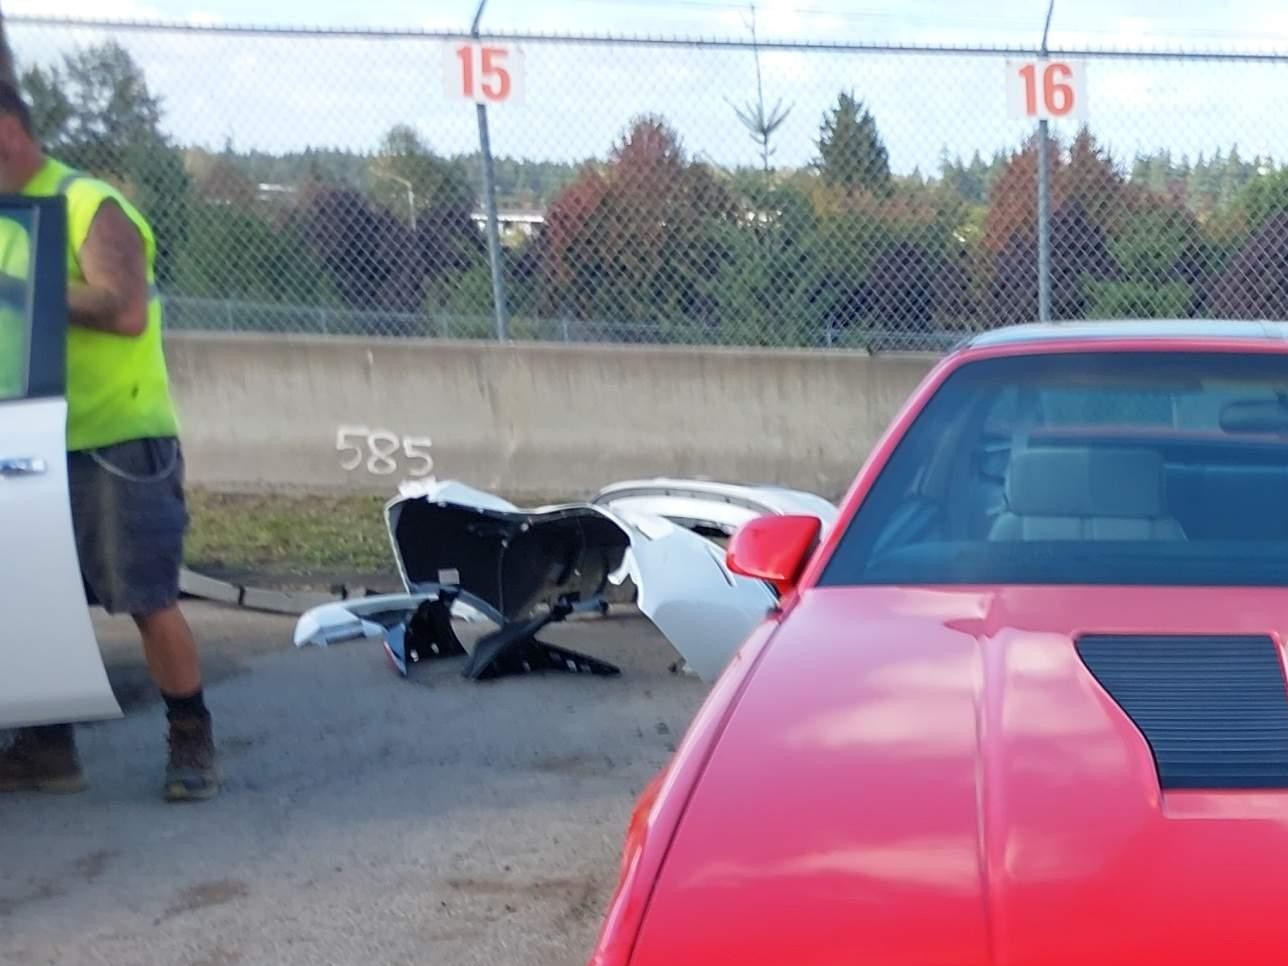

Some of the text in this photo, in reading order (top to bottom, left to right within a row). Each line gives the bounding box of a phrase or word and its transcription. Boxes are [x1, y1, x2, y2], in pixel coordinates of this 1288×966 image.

[456, 46, 511, 101] 15
[1018, 63, 1074, 116] 16
[336, 425, 434, 477] 585
